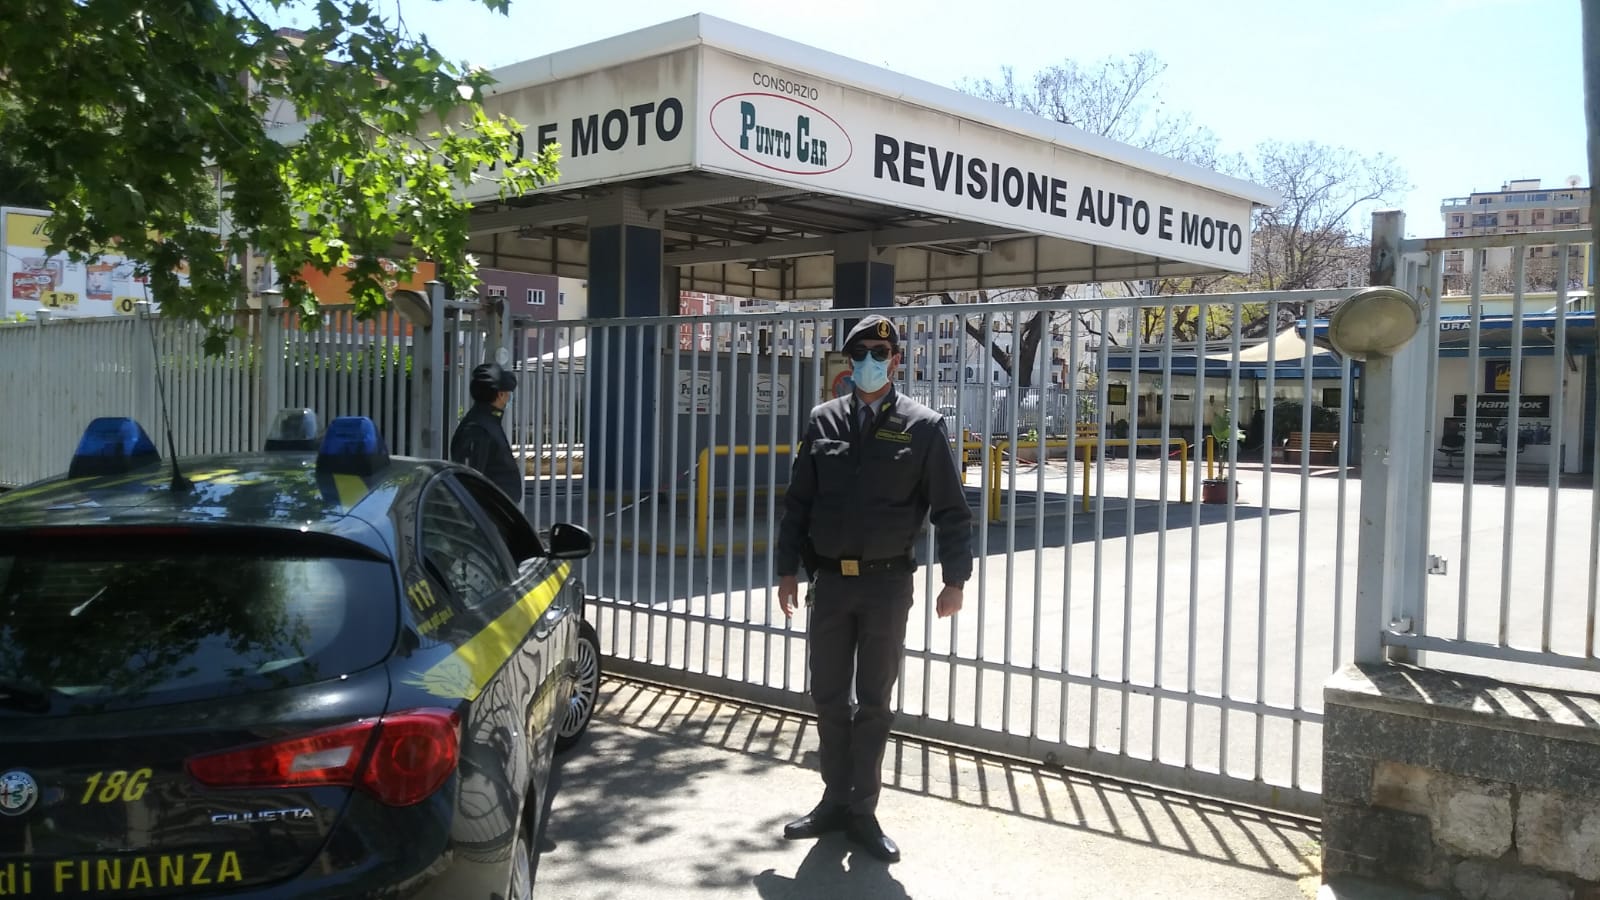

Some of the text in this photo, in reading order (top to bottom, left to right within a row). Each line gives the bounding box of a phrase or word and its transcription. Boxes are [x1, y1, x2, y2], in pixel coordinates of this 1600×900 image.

[752, 72, 819, 101] CONSORZIO
[571, 97, 684, 158] MOTO
[740, 100, 828, 167] PUNTO CAR
[873, 133, 1243, 255] REVISIONE AUTO E MOTO
[407, 579, 436, 611] 117
[80, 768, 153, 805] 18G
[211, 807, 315, 825] GIULIETTA
[0, 850, 243, 895] di FINANZA
